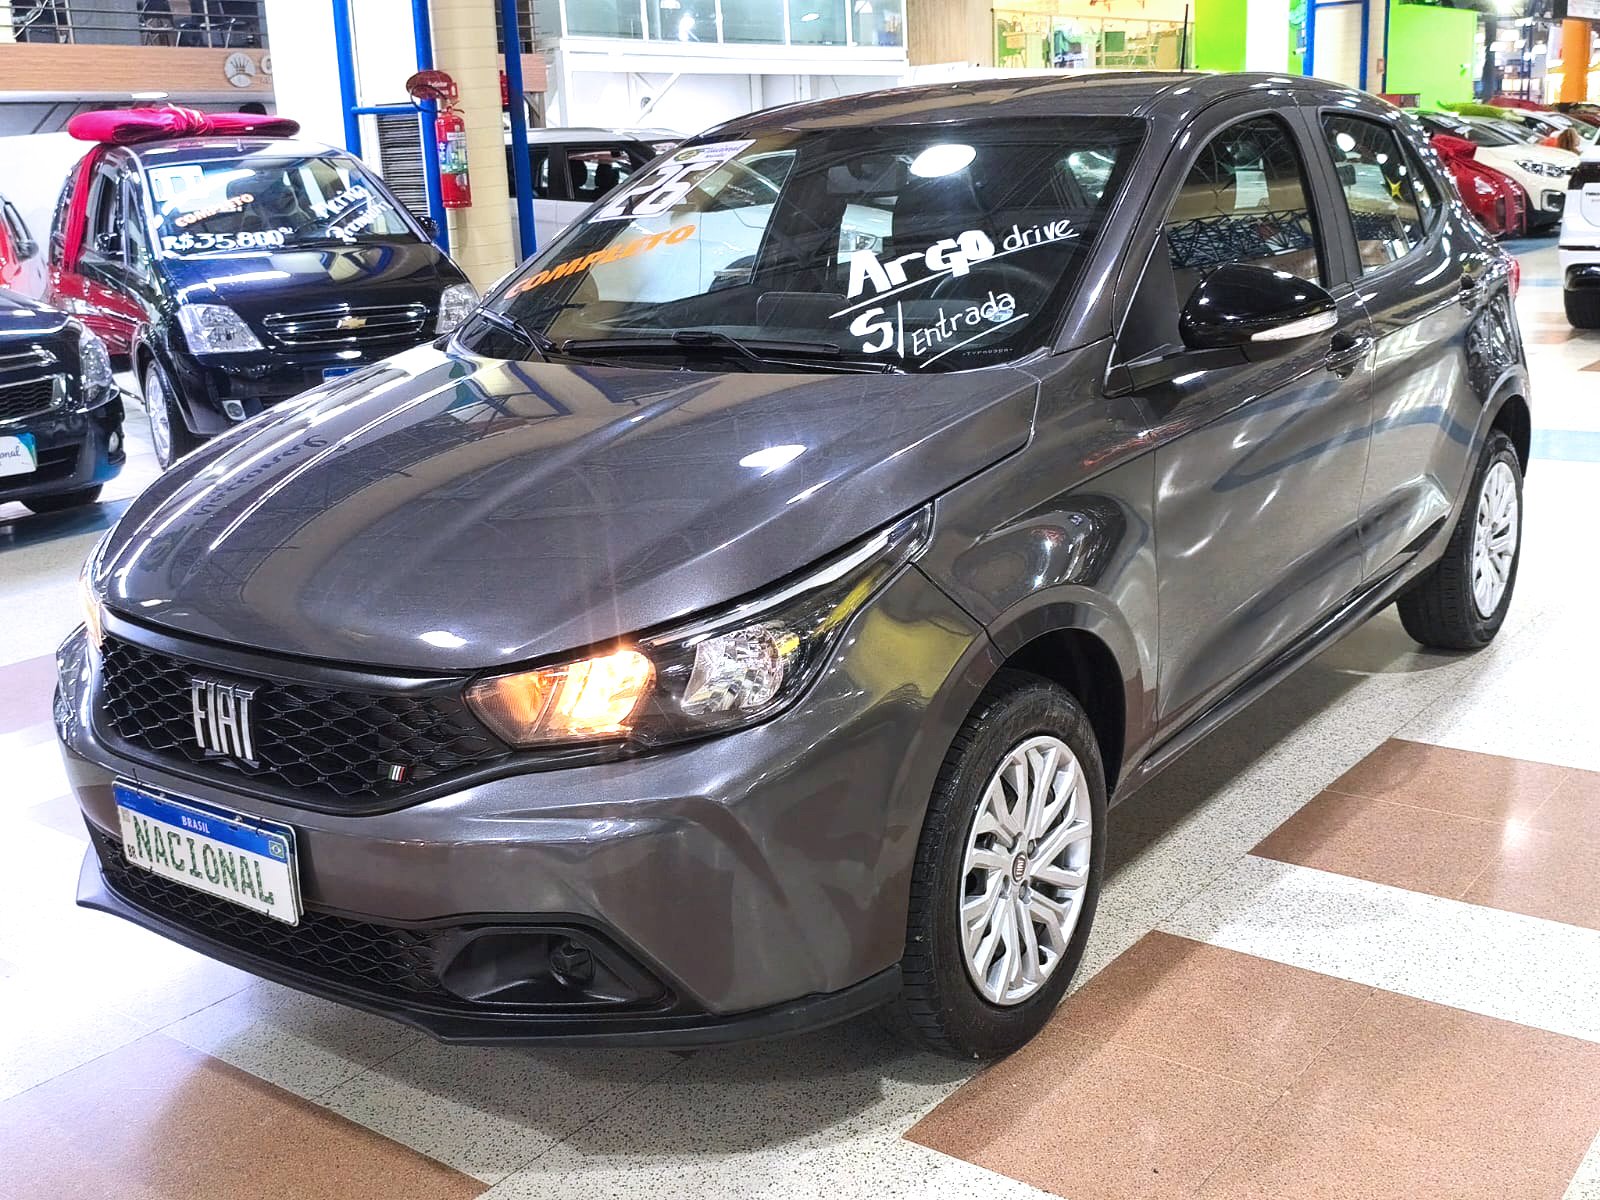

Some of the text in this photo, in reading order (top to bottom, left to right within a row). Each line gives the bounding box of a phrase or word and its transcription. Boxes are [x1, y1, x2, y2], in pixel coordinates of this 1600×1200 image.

[1002, 219, 1074, 251] drive
[191, 678, 255, 761] FIAT
[181, 814, 211, 834] BRASIL
[132, 815, 276, 906] NACIONAL
